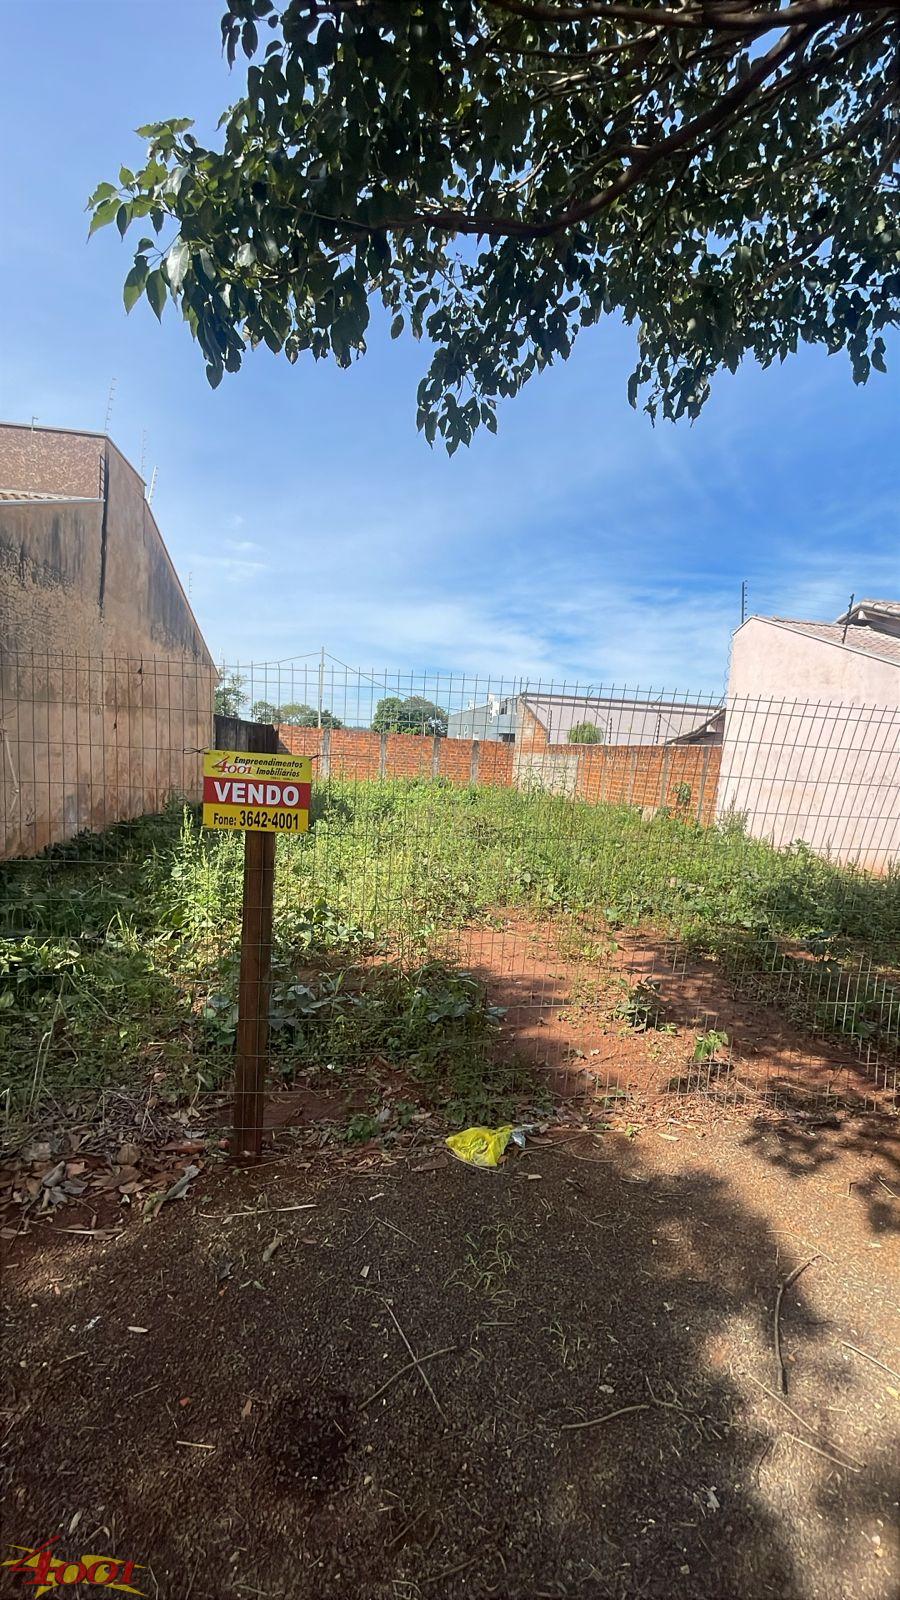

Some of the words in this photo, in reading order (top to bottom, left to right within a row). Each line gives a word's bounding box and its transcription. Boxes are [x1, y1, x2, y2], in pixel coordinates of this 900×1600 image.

[212, 755, 252, 775] 4001
[234, 756, 303, 768] Empreendimentos
[213, 781, 299, 806] VENDO
[213, 812, 237, 826] Fone:
[240, 810, 299, 830] 3642-4001
